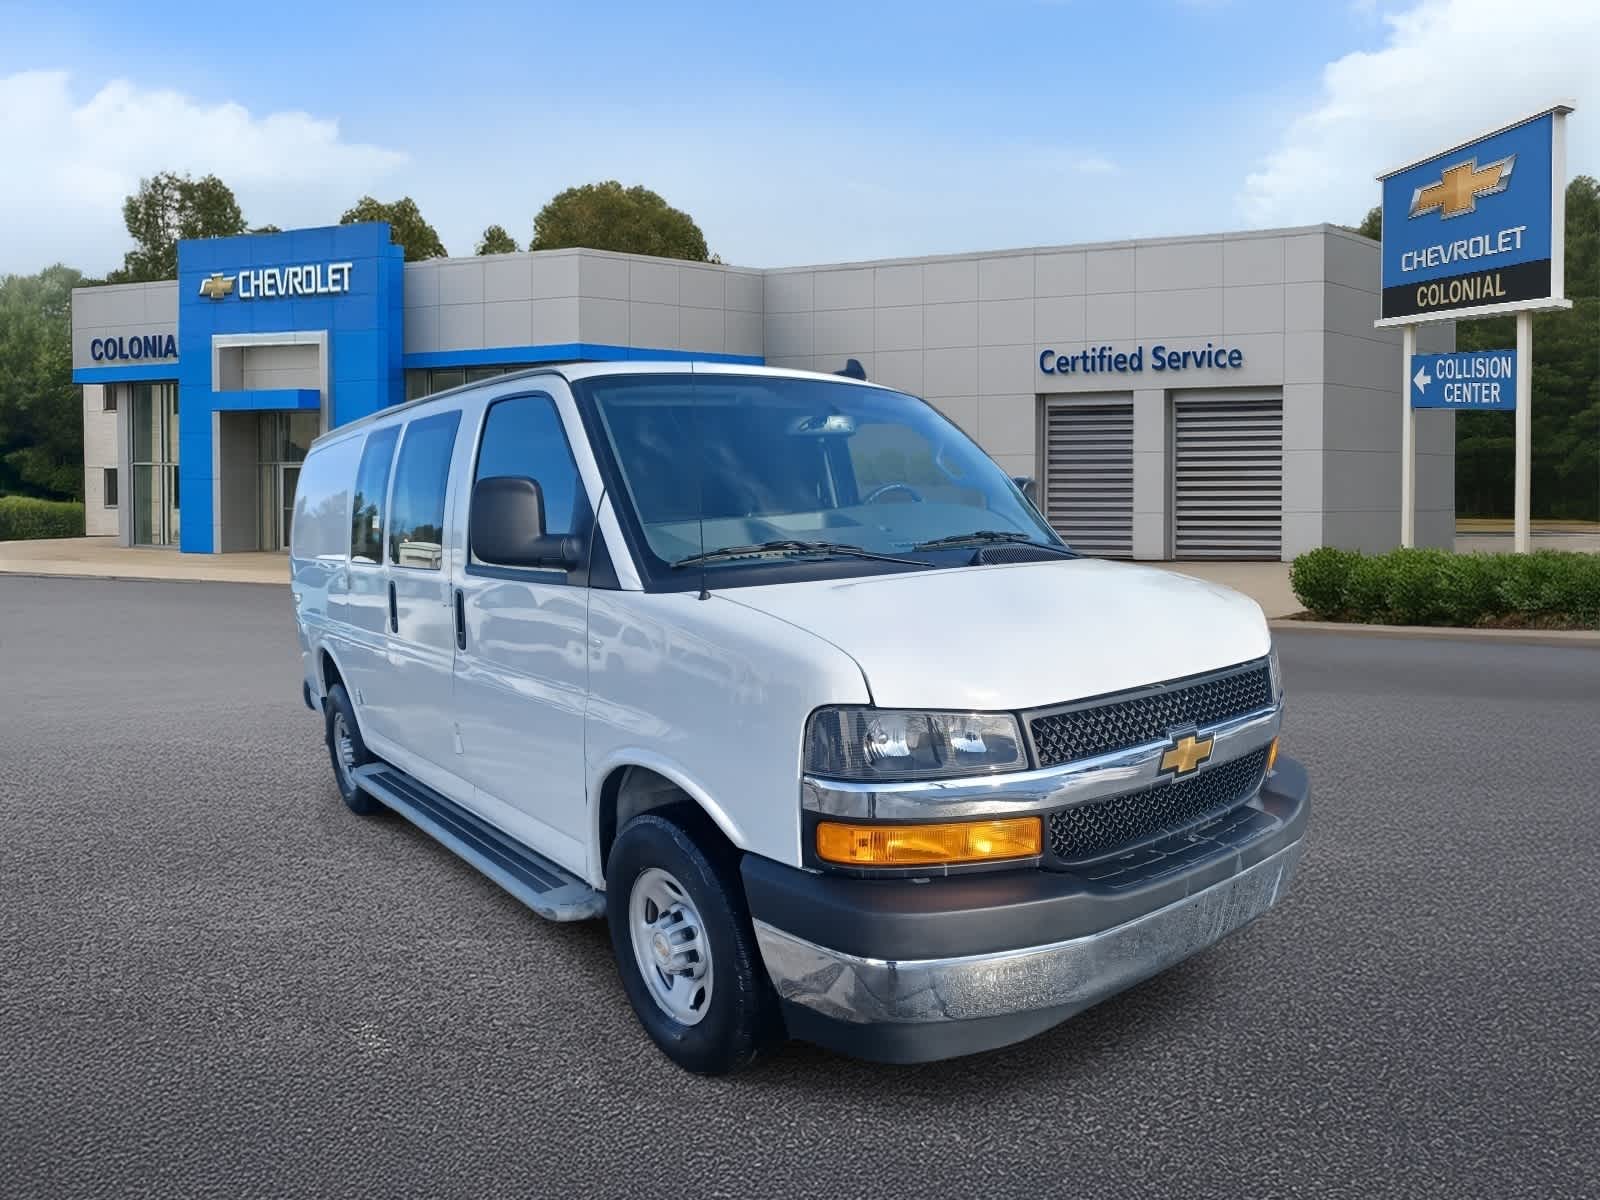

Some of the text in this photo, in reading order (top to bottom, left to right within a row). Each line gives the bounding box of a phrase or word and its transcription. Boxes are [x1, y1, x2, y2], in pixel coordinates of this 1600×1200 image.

[1402, 226, 1527, 272] CHEVROLET
[239, 262, 353, 297] CHEVROLET
[1417, 274, 1506, 307] COLONIAL
[91, 335, 178, 361] COLONIA
[1039, 343, 1243, 374] Certified Service
[1436, 356, 1512, 379] COLLISION
[1444, 383, 1500, 403] CENTER
